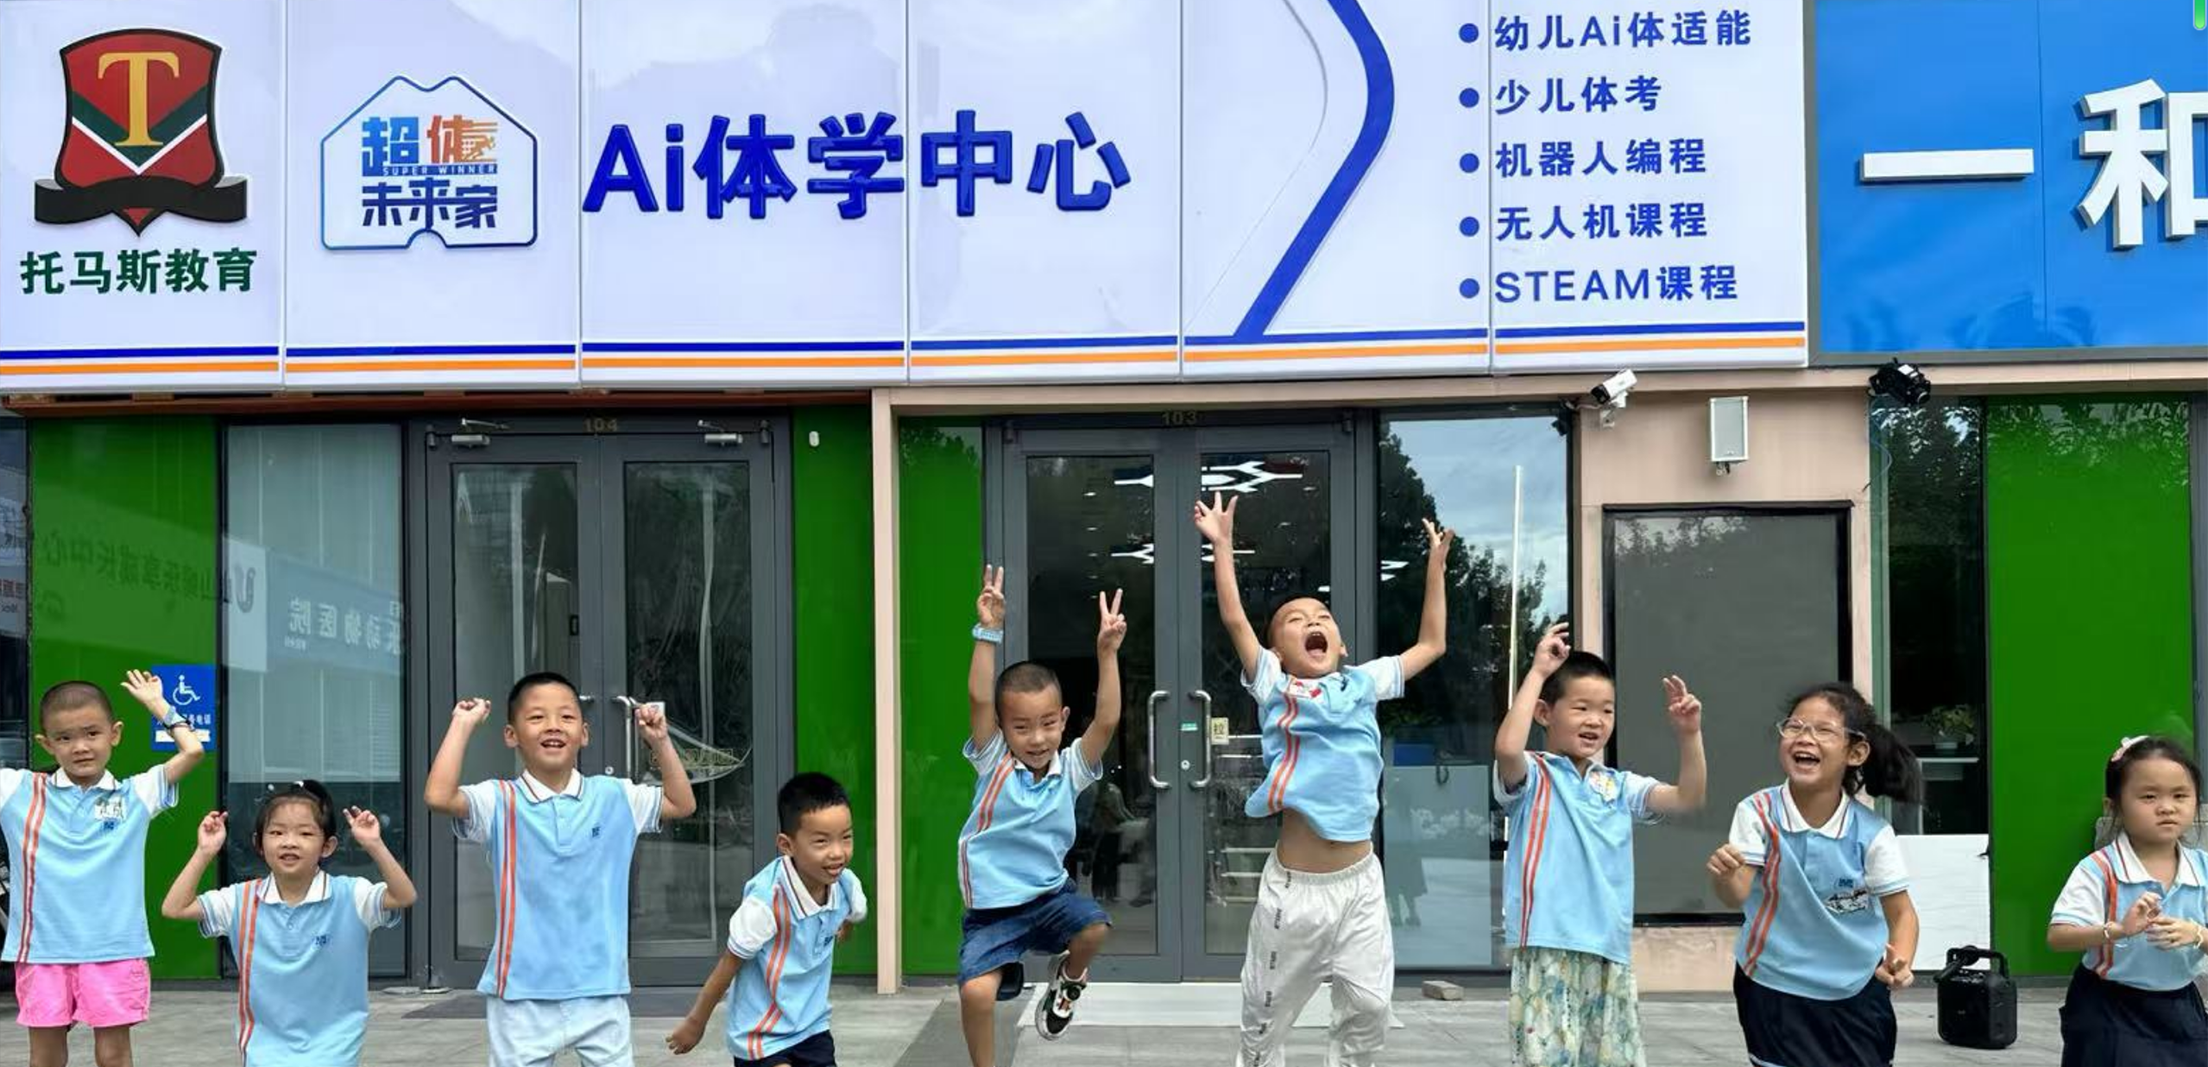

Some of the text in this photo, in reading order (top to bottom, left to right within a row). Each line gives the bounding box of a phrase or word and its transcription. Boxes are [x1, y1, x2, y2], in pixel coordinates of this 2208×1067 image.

[1495, 10, 1752, 51] 幼儿Ai体适能
[100, 52, 180, 147] T
[1496, 75, 1662, 115] 少儿体考
[382, 164, 496, 176] SUPER WINNER
[582, 110, 1132, 220] Ai体学中心
[1496, 138, 1707, 178] 机器人编程
[362, 177, 498, 229] 未来家
[1497, 202, 1708, 242] 无人机课程
[20, 248, 258, 295] 托马斯教育
[1495, 265, 1739, 304] STEAM课程
[583, 417, 618, 433] 104
[1161, 409, 1197, 426] 103
